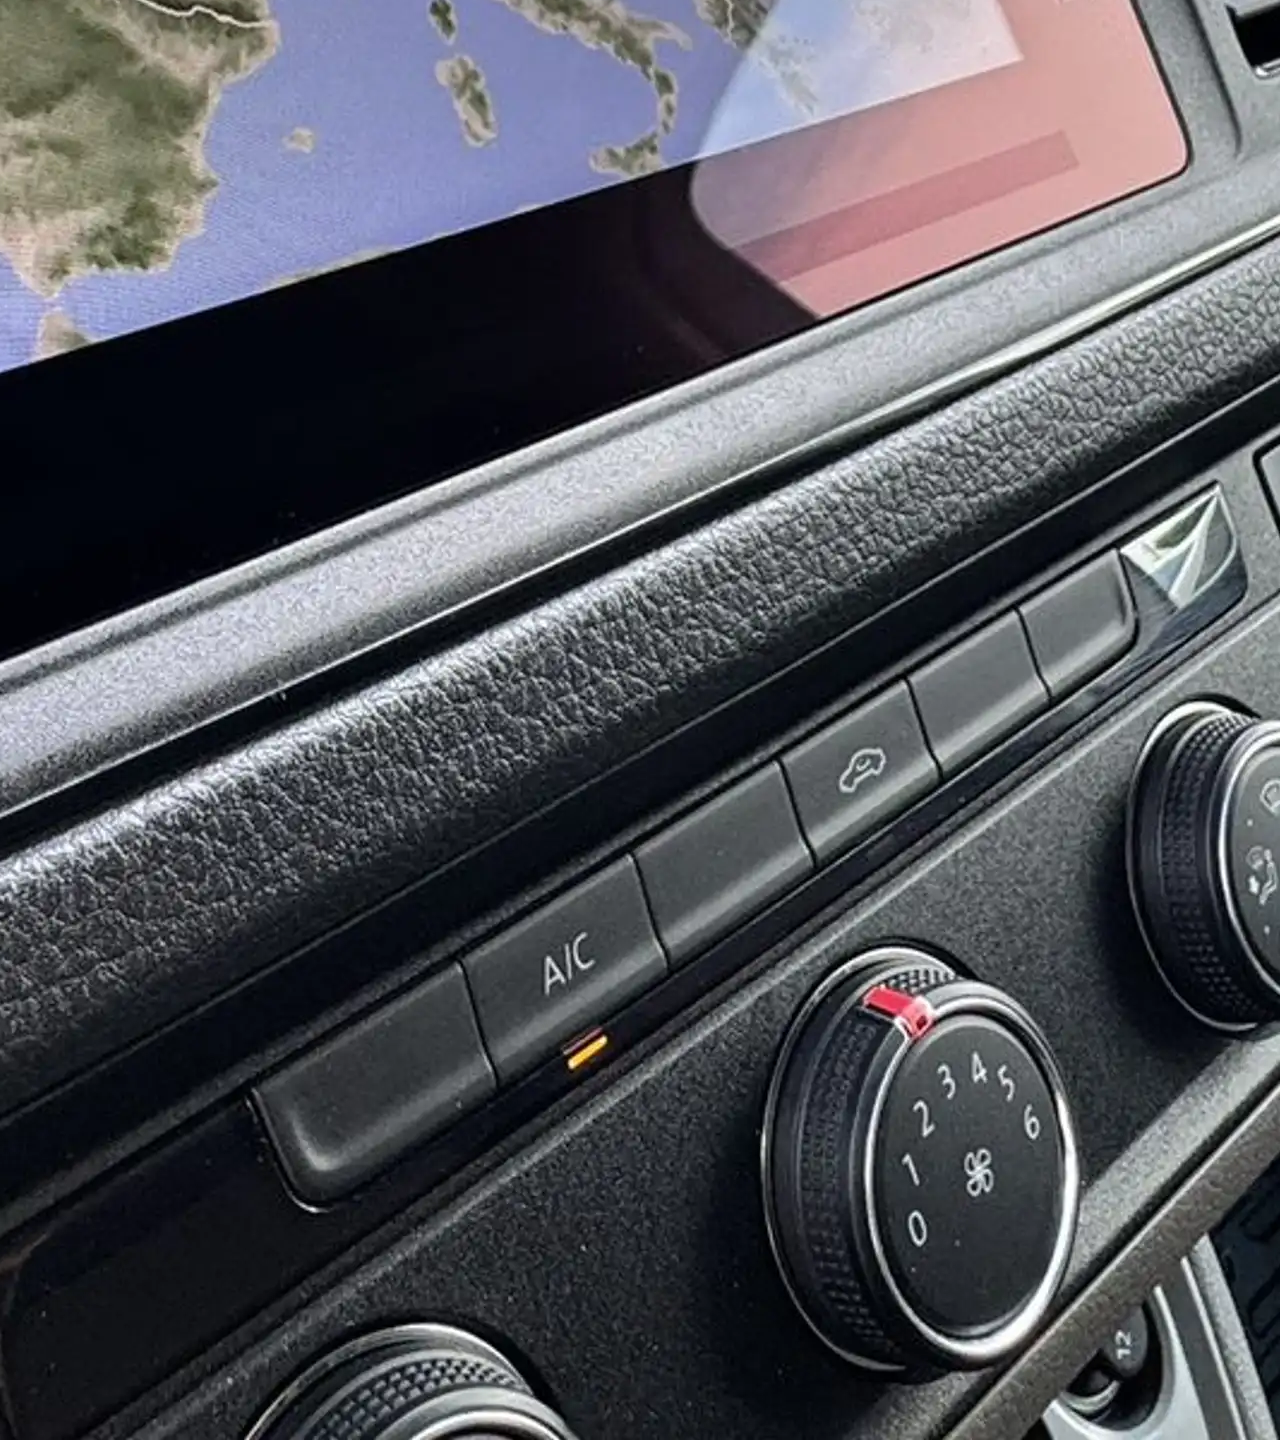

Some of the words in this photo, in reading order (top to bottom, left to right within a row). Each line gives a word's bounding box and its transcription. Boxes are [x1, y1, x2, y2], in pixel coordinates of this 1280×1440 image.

[543, 931, 596, 996] A/C
[936, 1063, 958, 1100] 3
[969, 1050, 989, 1086] 4
[996, 1063, 1016, 1102] 5
[912, 1099, 936, 1139] 2
[1022, 1102, 1041, 1141] 6
[901, 1152, 921, 1187] 1
[907, 1209, 928, 1248] 0
